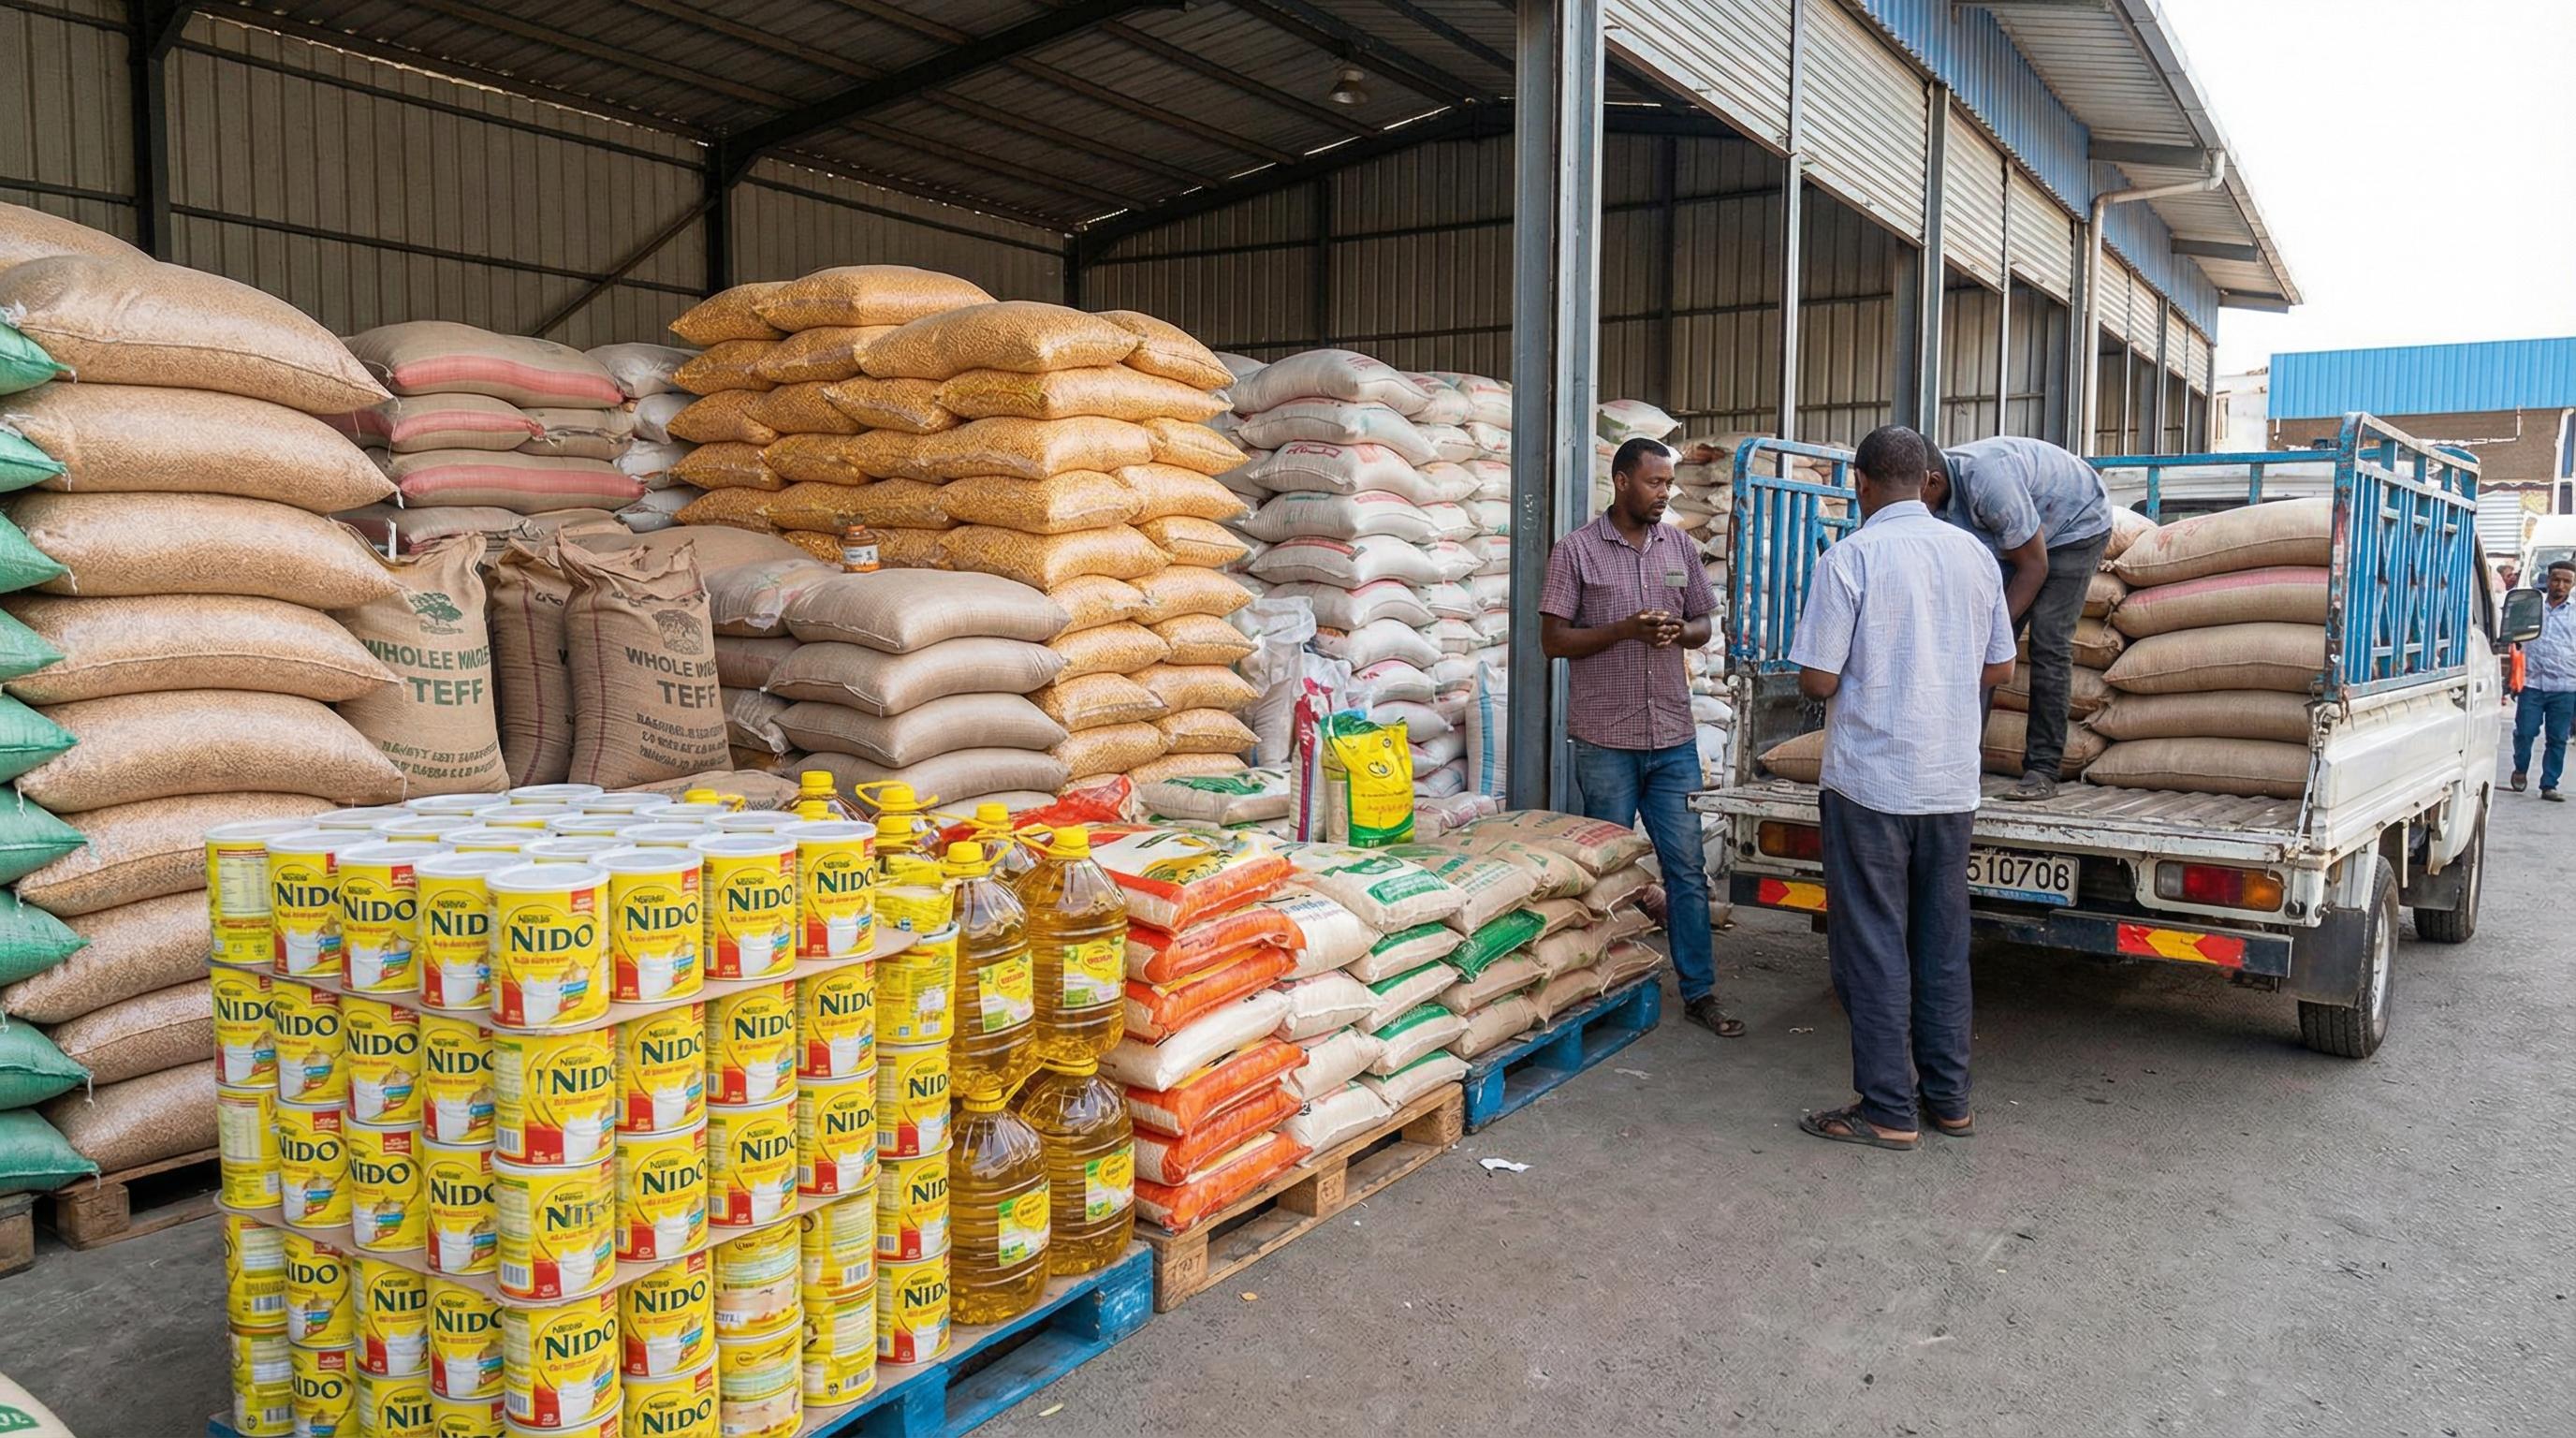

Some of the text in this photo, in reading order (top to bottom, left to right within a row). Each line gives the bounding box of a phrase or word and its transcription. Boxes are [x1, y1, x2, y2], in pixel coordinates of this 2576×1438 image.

[361, 638, 454, 670] WHOLEE
[624, 646, 693, 678] WHOLE
[406, 675, 483, 706] TEFF
[657, 680, 715, 709] TEFF
[1967, 855, 2070, 891] 510706
[344, 896, 417, 922] NIDO
[727, 884, 793, 912] NIDO
[626, 902, 698, 932] NIDO
[510, 924, 593, 953] NIDO
[346, 1030, 418, 1056] NIDO
[635, 1280, 706, 1313] NIDO
[545, 1318, 616, 1360] NIDO
[642, 1398, 712, 1435] NIDO
